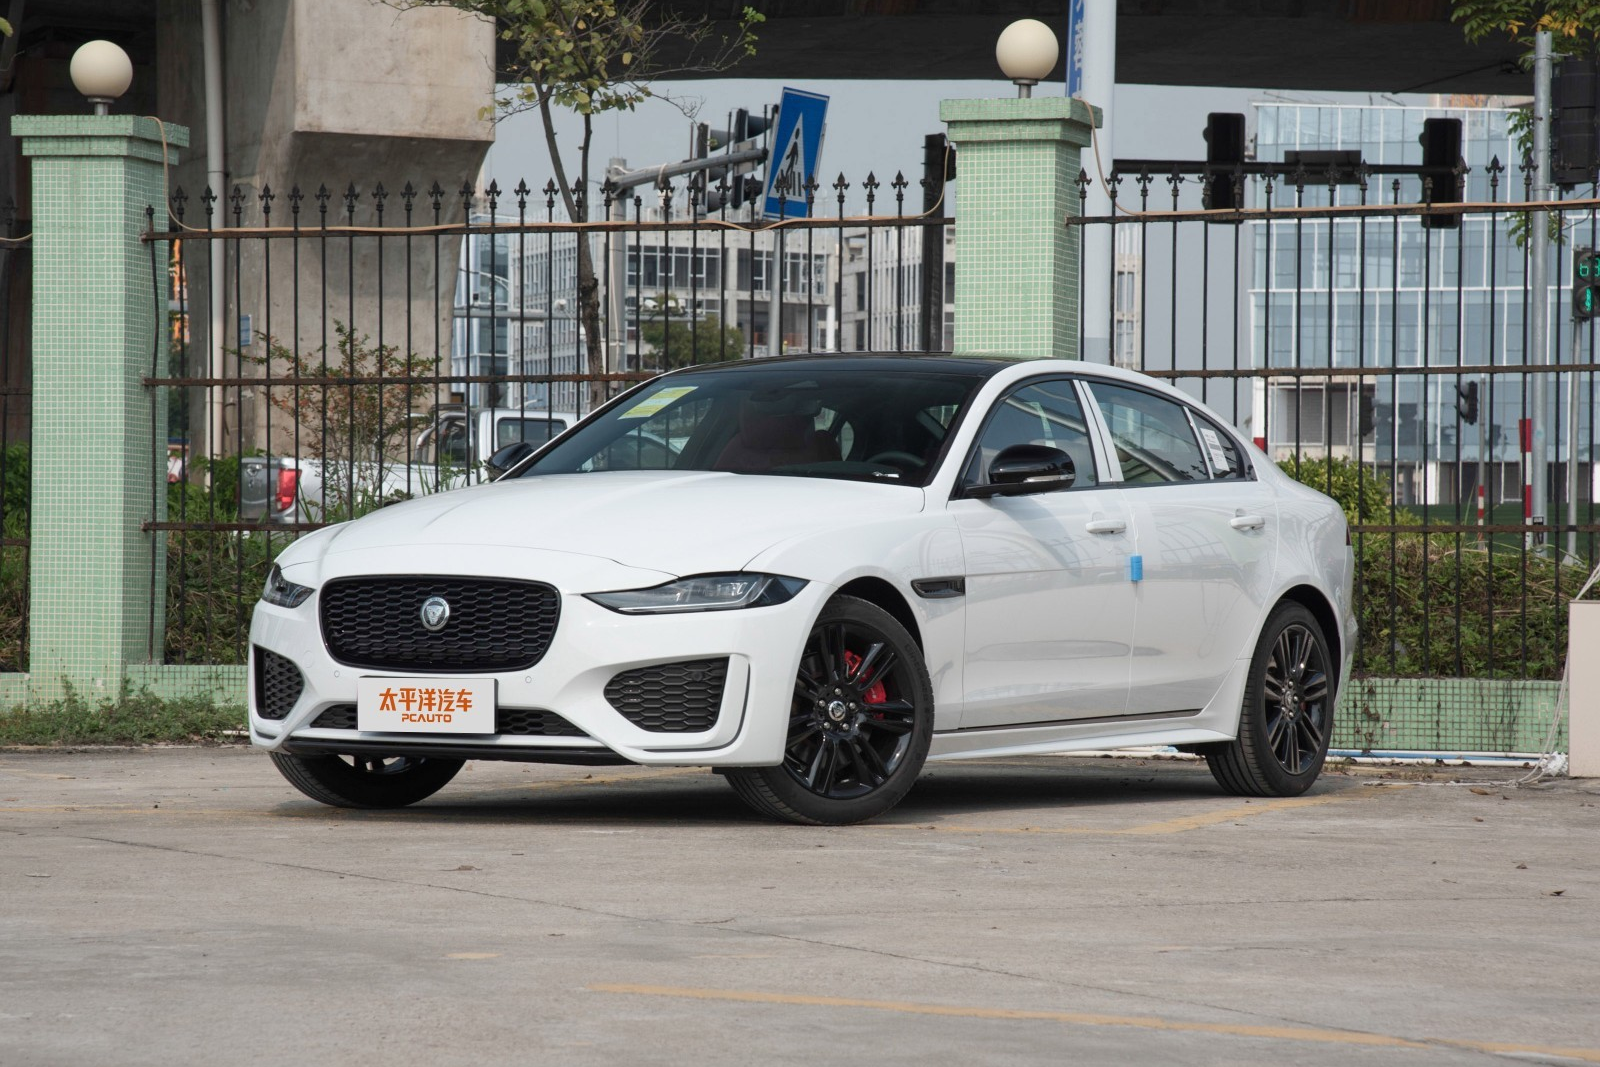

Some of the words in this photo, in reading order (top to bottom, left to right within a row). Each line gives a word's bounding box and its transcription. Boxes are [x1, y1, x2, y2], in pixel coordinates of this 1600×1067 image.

[378, 687, 473, 712] 太平洋汽车
[401, 713, 452, 723] PCAUTO
